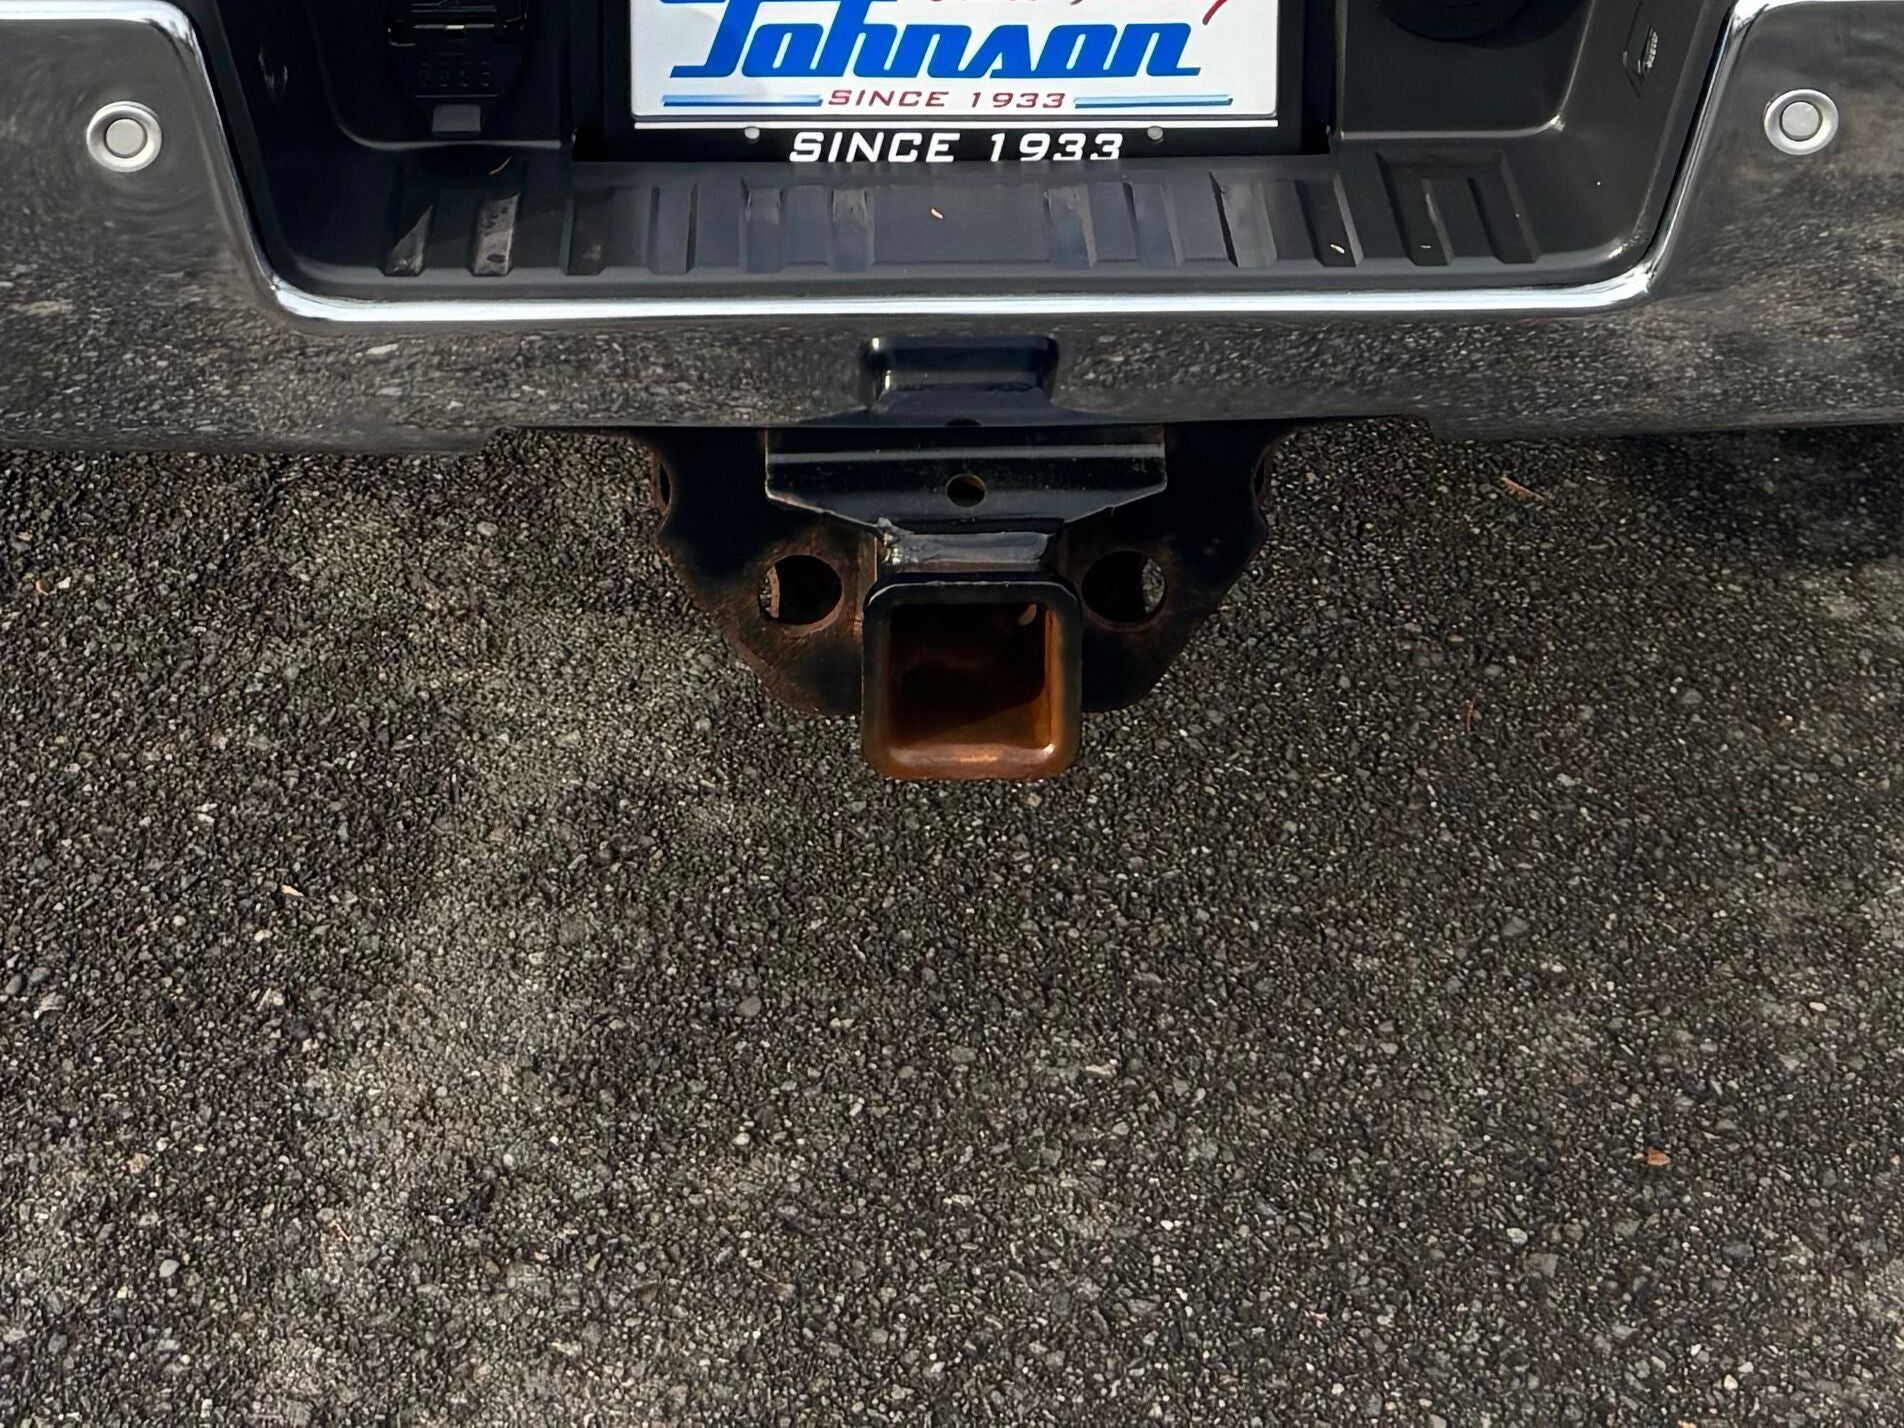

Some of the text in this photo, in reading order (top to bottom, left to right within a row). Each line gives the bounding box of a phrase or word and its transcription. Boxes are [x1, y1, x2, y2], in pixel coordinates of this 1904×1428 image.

[828, 89, 1066, 109] SINCE 1933
[789, 131, 1124, 163] SINCE 1933
